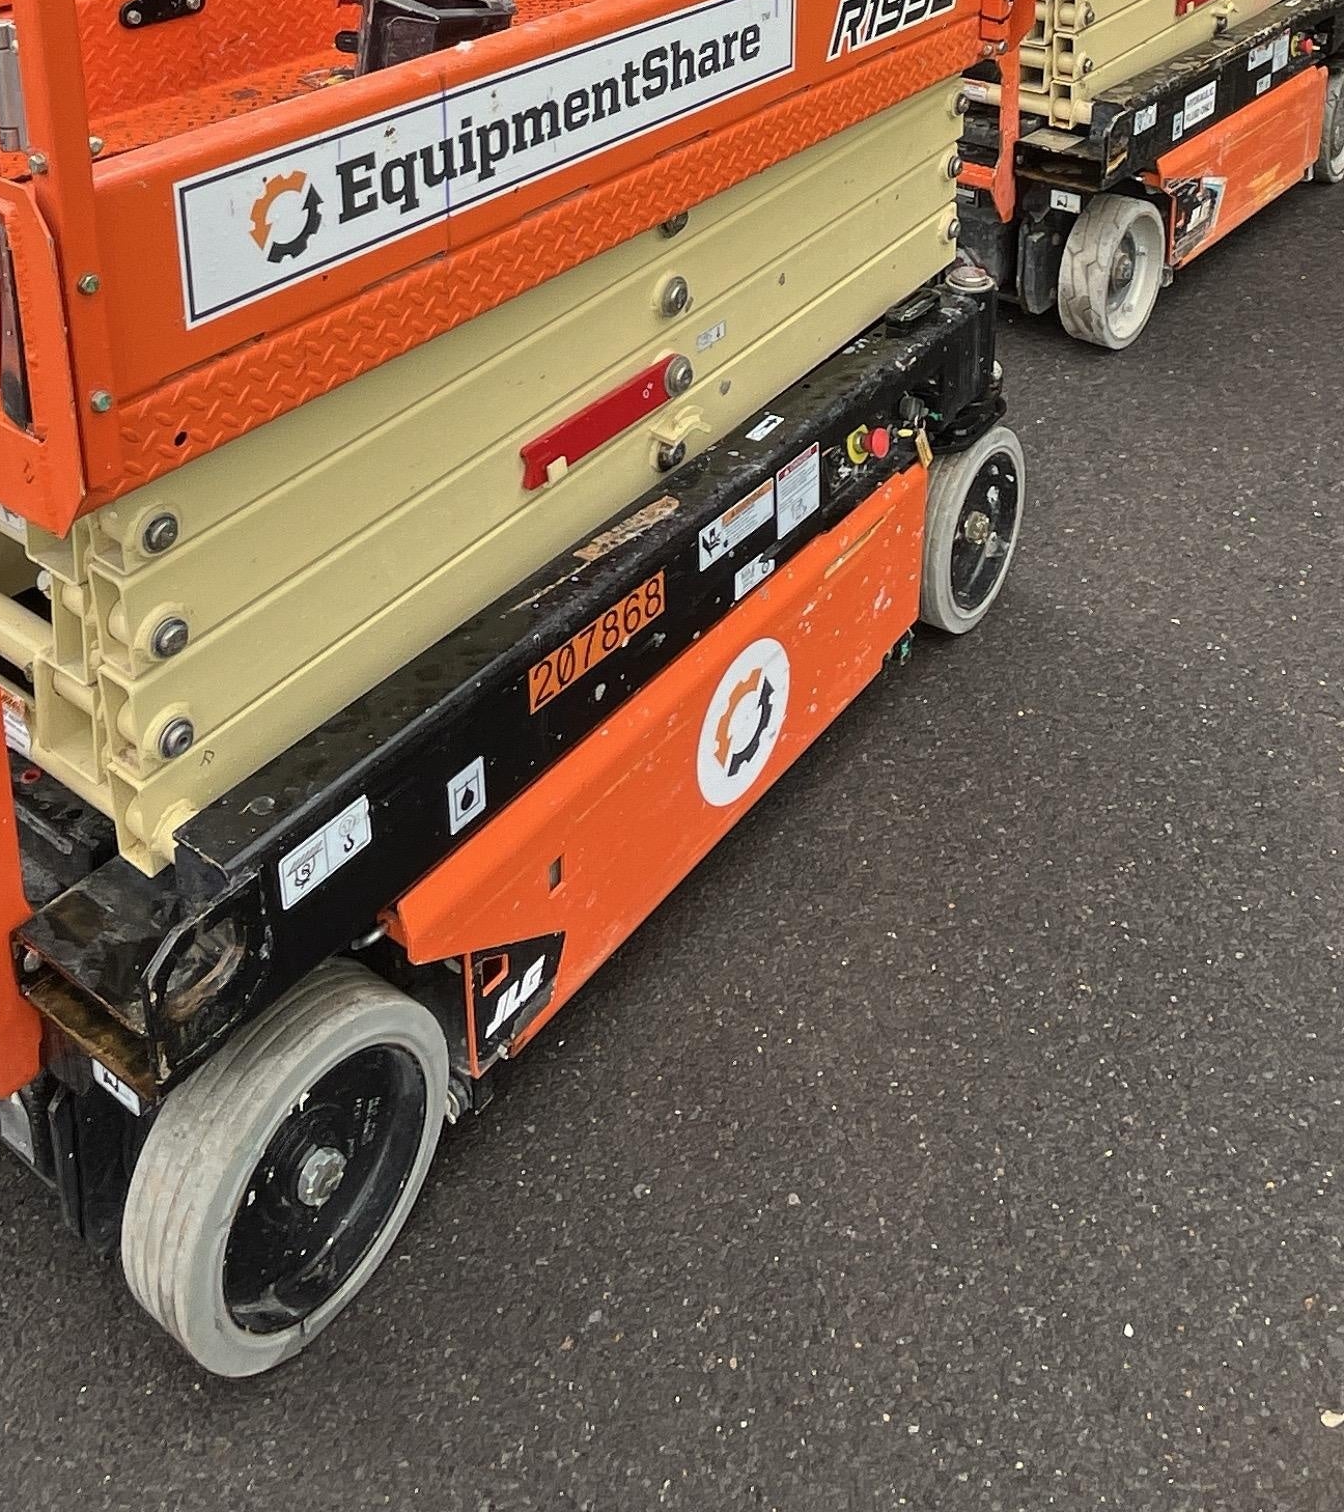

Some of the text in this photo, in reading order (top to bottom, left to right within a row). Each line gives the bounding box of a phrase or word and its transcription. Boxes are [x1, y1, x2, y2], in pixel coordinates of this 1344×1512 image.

[336, 19, 762, 224] EquipmentShare
[533, 577, 662, 709] 207868
[484, 953, 546, 1039] JLG
